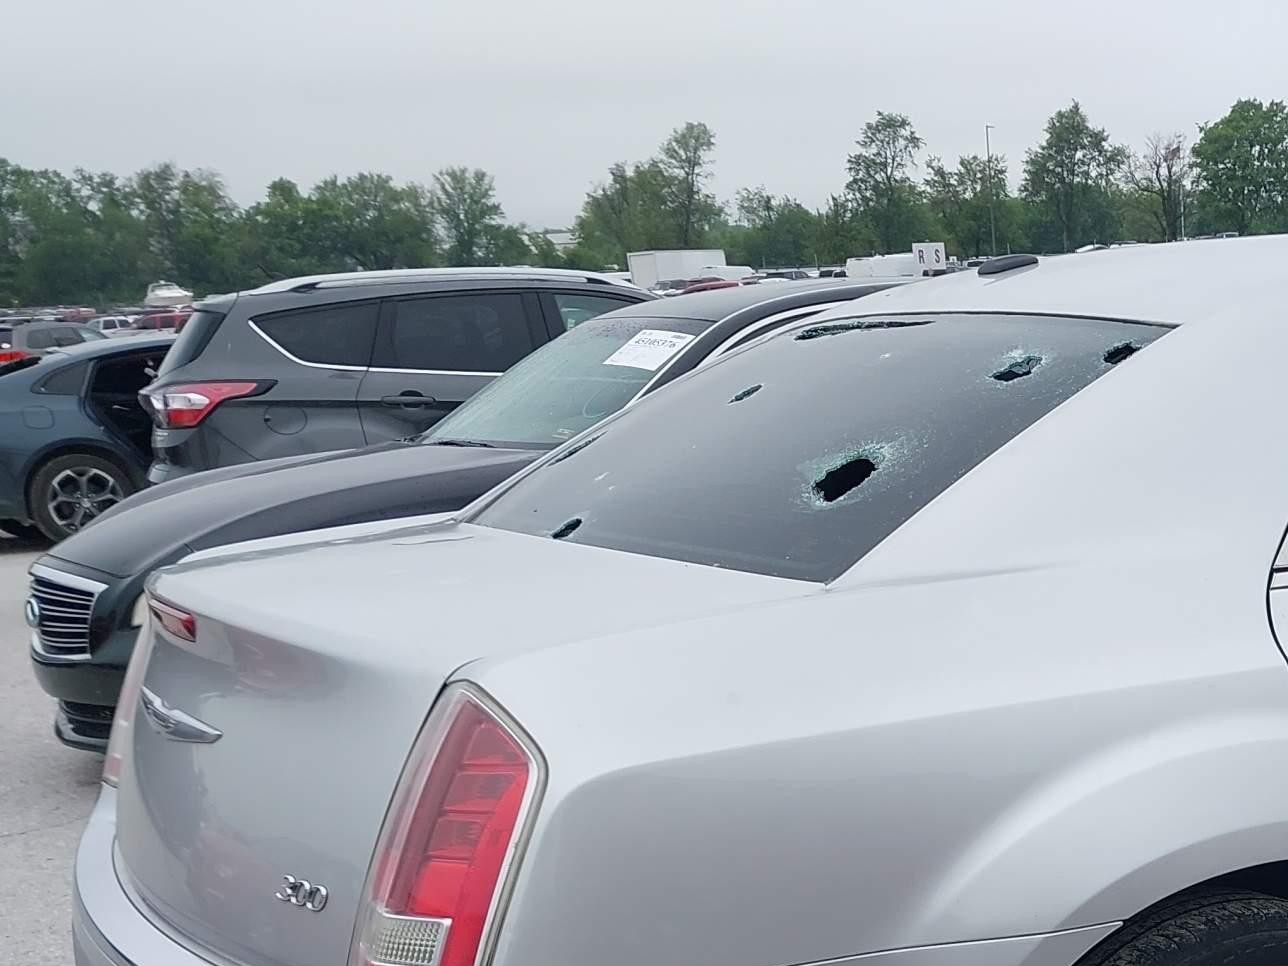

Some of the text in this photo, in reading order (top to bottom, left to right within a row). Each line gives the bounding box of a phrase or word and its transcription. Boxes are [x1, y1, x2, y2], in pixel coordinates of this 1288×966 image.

[918, 249, 941, 264] R S
[275, 873, 328, 912] 300
